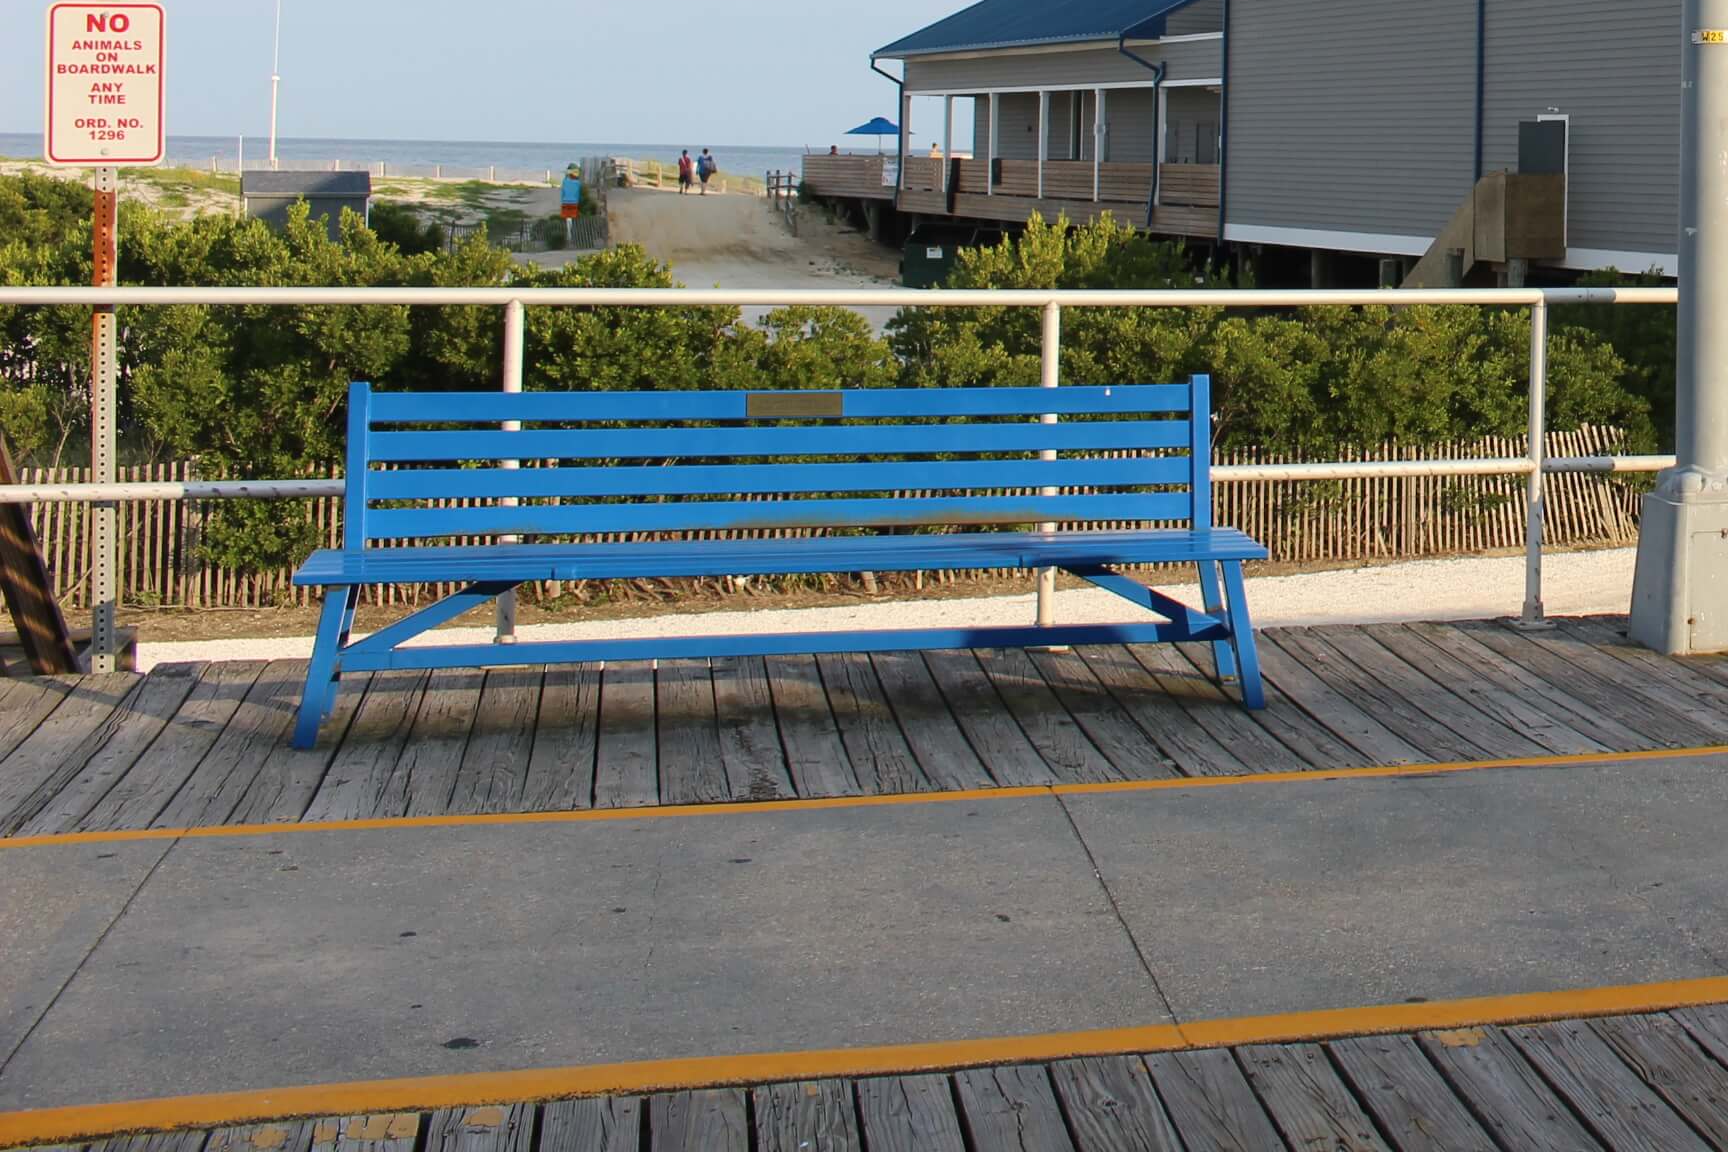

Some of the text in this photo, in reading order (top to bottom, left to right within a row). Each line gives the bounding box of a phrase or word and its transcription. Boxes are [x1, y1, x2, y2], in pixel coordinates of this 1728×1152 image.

[86, 13, 130, 33] NO
[71, 40, 143, 51] ANIMALS
[96, 52, 119, 62] ON
[56, 64, 156, 75] BOARDWALK
[91, 82, 124, 93] ANY
[88, 94, 126, 105] TIME
[74, 118, 144, 129] ORD. NO.
[88, 130, 125, 141] 1296
